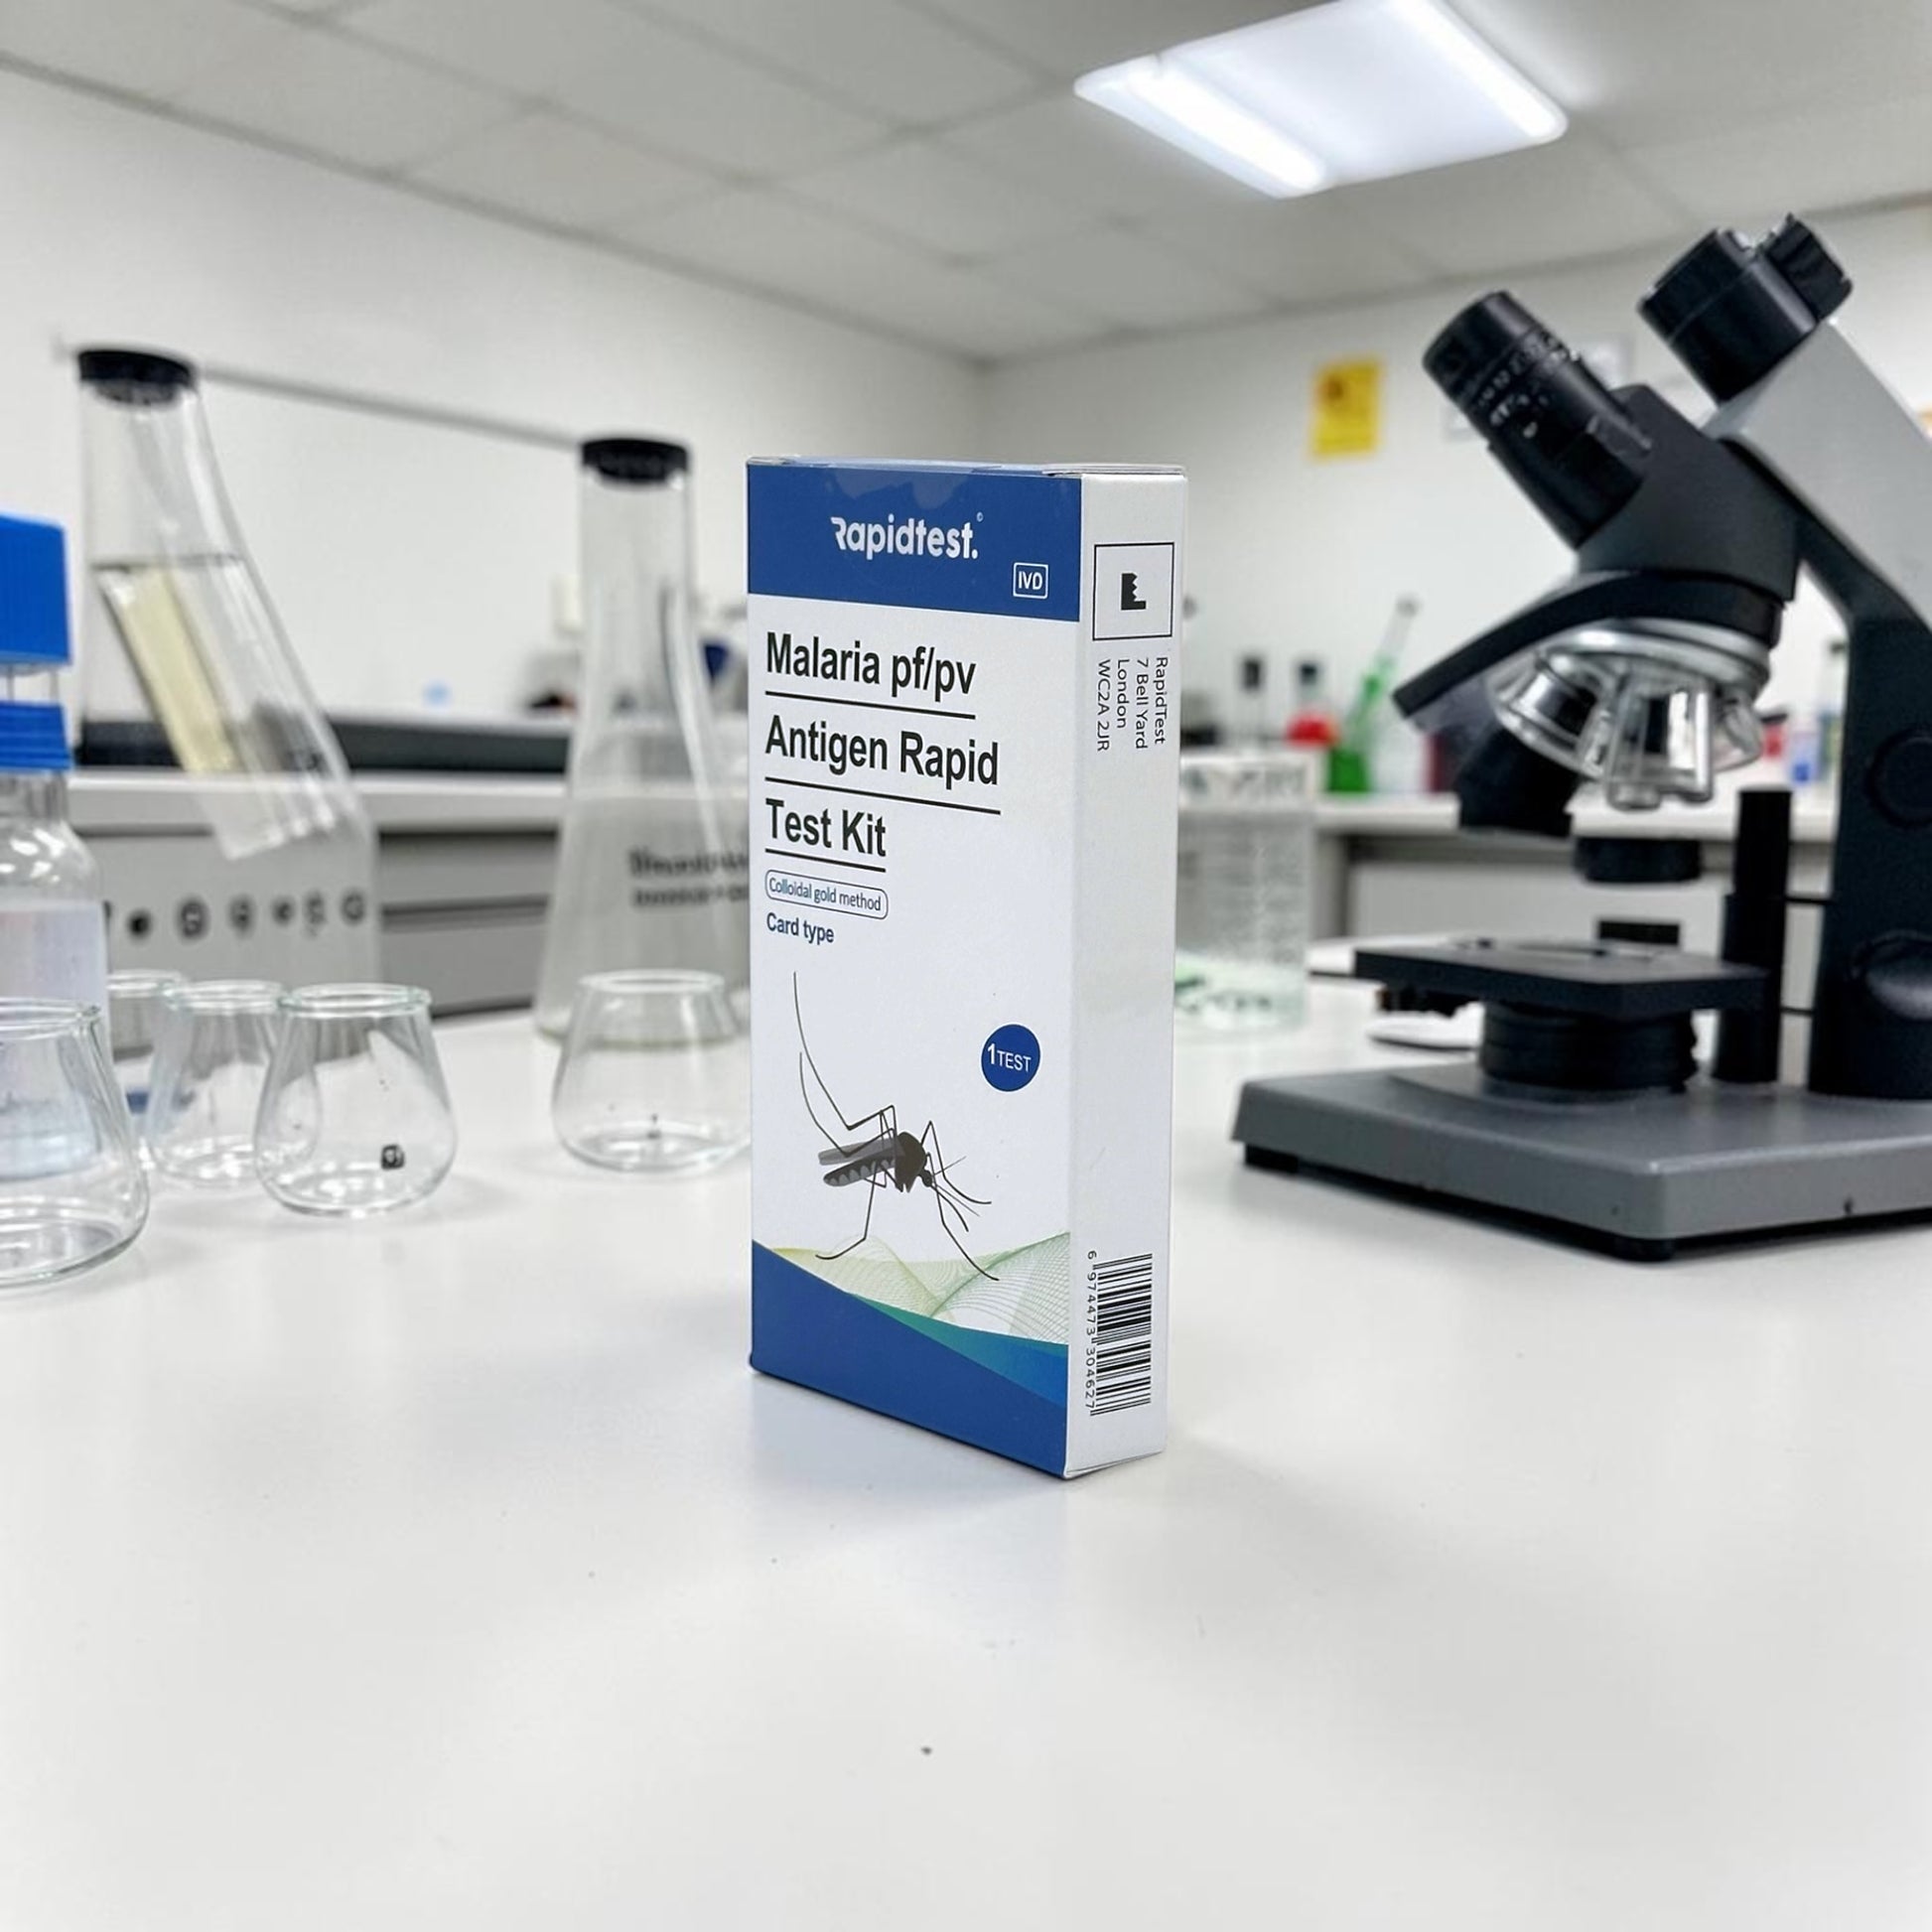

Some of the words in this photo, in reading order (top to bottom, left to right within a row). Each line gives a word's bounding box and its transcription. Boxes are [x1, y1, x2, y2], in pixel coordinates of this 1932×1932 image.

[1018, 571, 1043, 590] IVD
[766, 631, 881, 684] Malaria
[892, 646, 976, 702] pf/pv
[1137, 657, 1149, 668] 7
[1097, 659, 1111, 715] WC2A
[1117, 659, 1130, 728] London
[1136, 674, 1149, 705] Bell
[1153, 657, 1168, 745] RapidTest
[764, 715, 888, 775] Antigen
[900, 731, 999, 790] Rapid
[1097, 721, 1110, 752] 2JR
[1135, 710, 1149, 749] Yard
[765, 797, 832, 848] Test
[842, 809, 886, 857] Kit
[769, 878, 812, 898] Colloidal
[814, 887, 836, 903] gold
[839, 893, 881, 911] method
[766, 912, 799, 936] Card
[803, 919, 834, 945] type
[1087, 1250, 1097, 1260] 6
[1086, 1272, 1097, 1336] 974473
[1085, 1347, 1096, 1409] 304627
